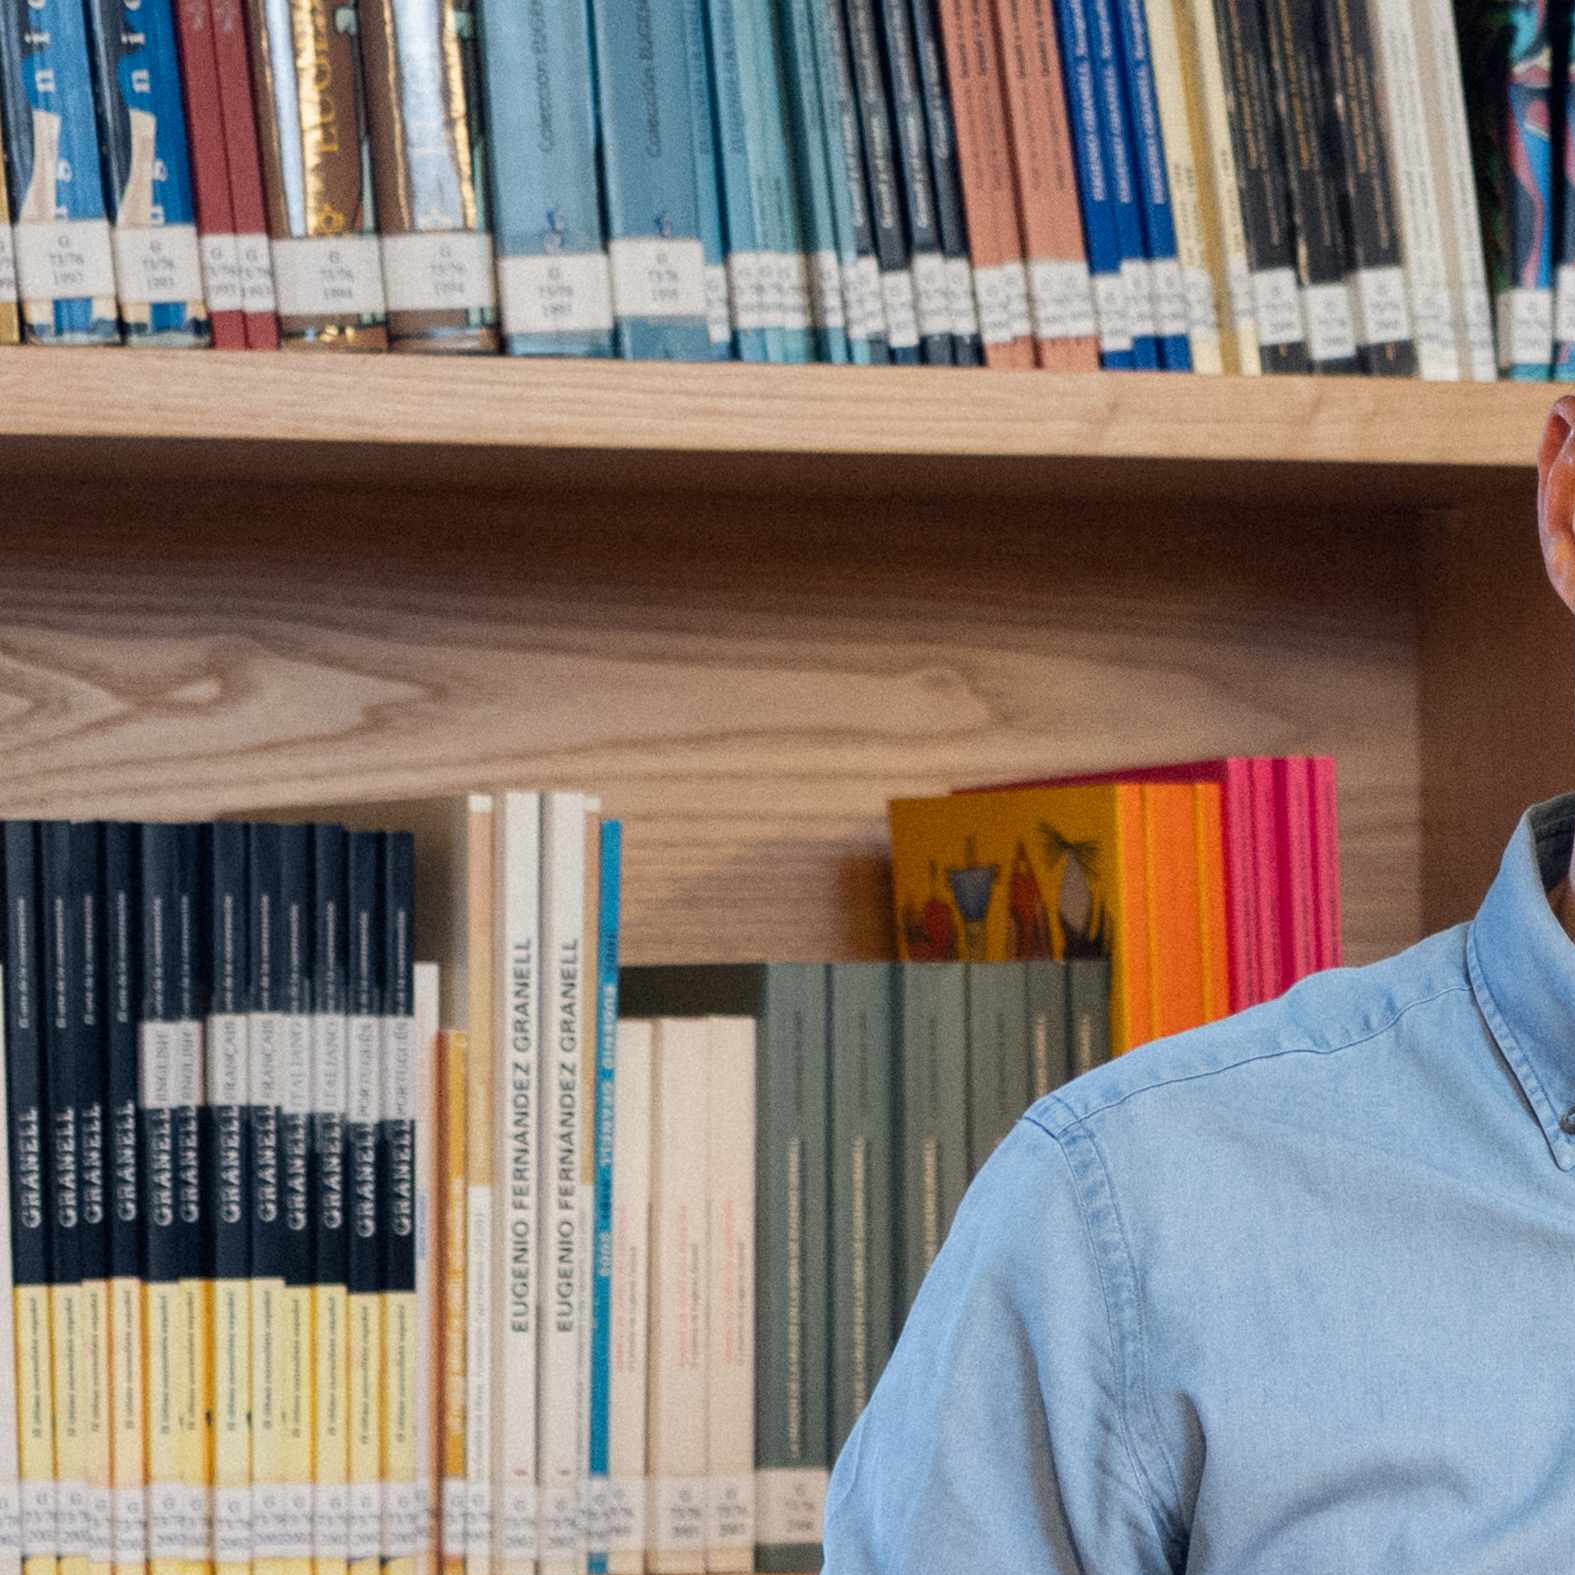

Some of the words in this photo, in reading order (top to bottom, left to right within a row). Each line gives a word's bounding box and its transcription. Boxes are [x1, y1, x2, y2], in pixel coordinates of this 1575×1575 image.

[513, 938, 532, 1053] GRANELL
[560, 938, 579, 1053] GRANELL
[17, 1107, 41, 1228] GRANELL
[55, 1107, 78, 1227] GRANELL
[82, 1103, 103, 1224] GRANELL
[116, 1100, 137, 1221] GRANELL
[153, 1108, 173, 1226] GRANELL
[179, 1106, 198, 1223] GRANELL
[220, 1105, 241, 1223] GRANELL
[256, 1106, 277, 1223] GRANELL
[288, 1113, 307, 1230] GRANELL
[322, 1113, 342, 1229] GRANELL
[393, 1119, 412, 1237] GRANELL
[511, 1062, 531, 1210] FERNÁNDEZ
[556, 1062, 577, 1210] FERNÁNDEZ
[511, 1220, 529, 1333] EUGENIO
[556, 1220, 574, 1333] EUGENIO
